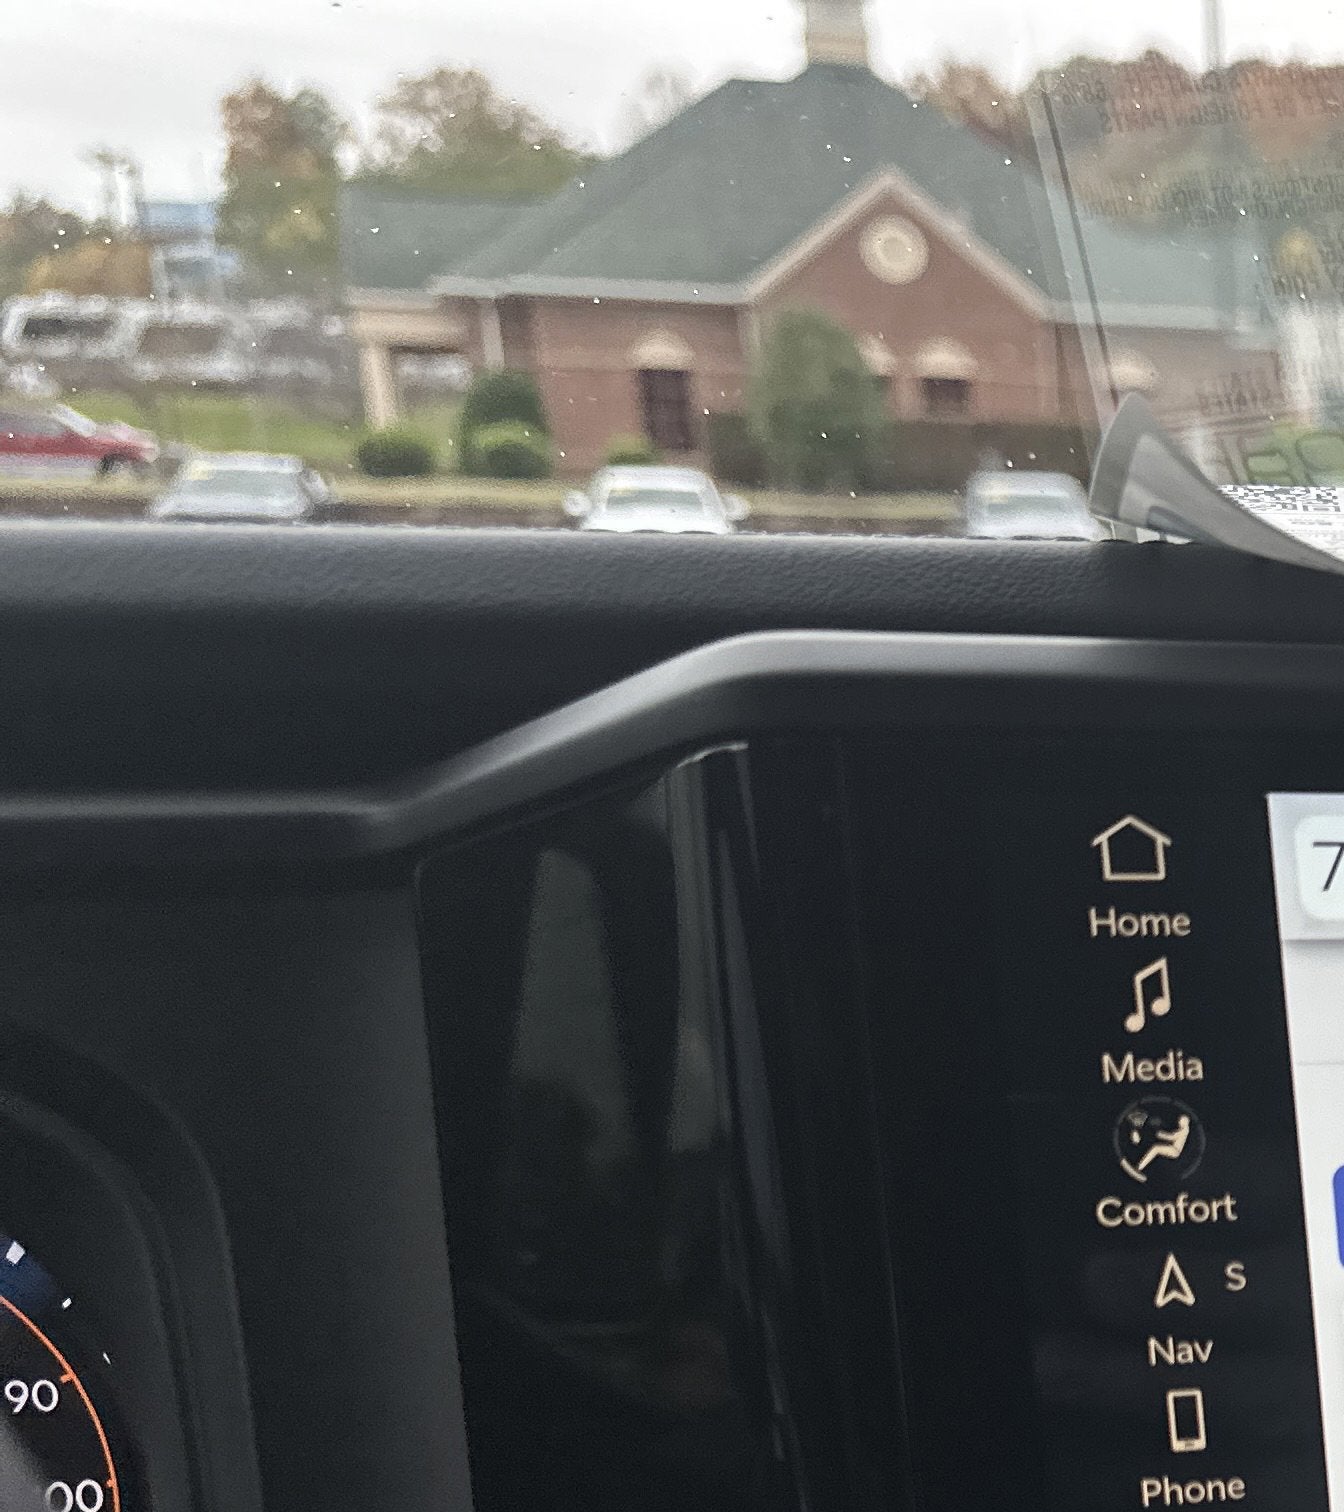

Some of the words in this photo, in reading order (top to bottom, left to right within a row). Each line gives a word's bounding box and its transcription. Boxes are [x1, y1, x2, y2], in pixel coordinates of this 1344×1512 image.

[1089, 908, 1191, 939] Home
[1101, 1052, 1205, 1085] Media
[1095, 1194, 1238, 1229] Comfort
[1147, 1336, 1214, 1367] Nav
[3, 1378, 59, 1414] 90
[1140, 1474, 1247, 1508] Phone
